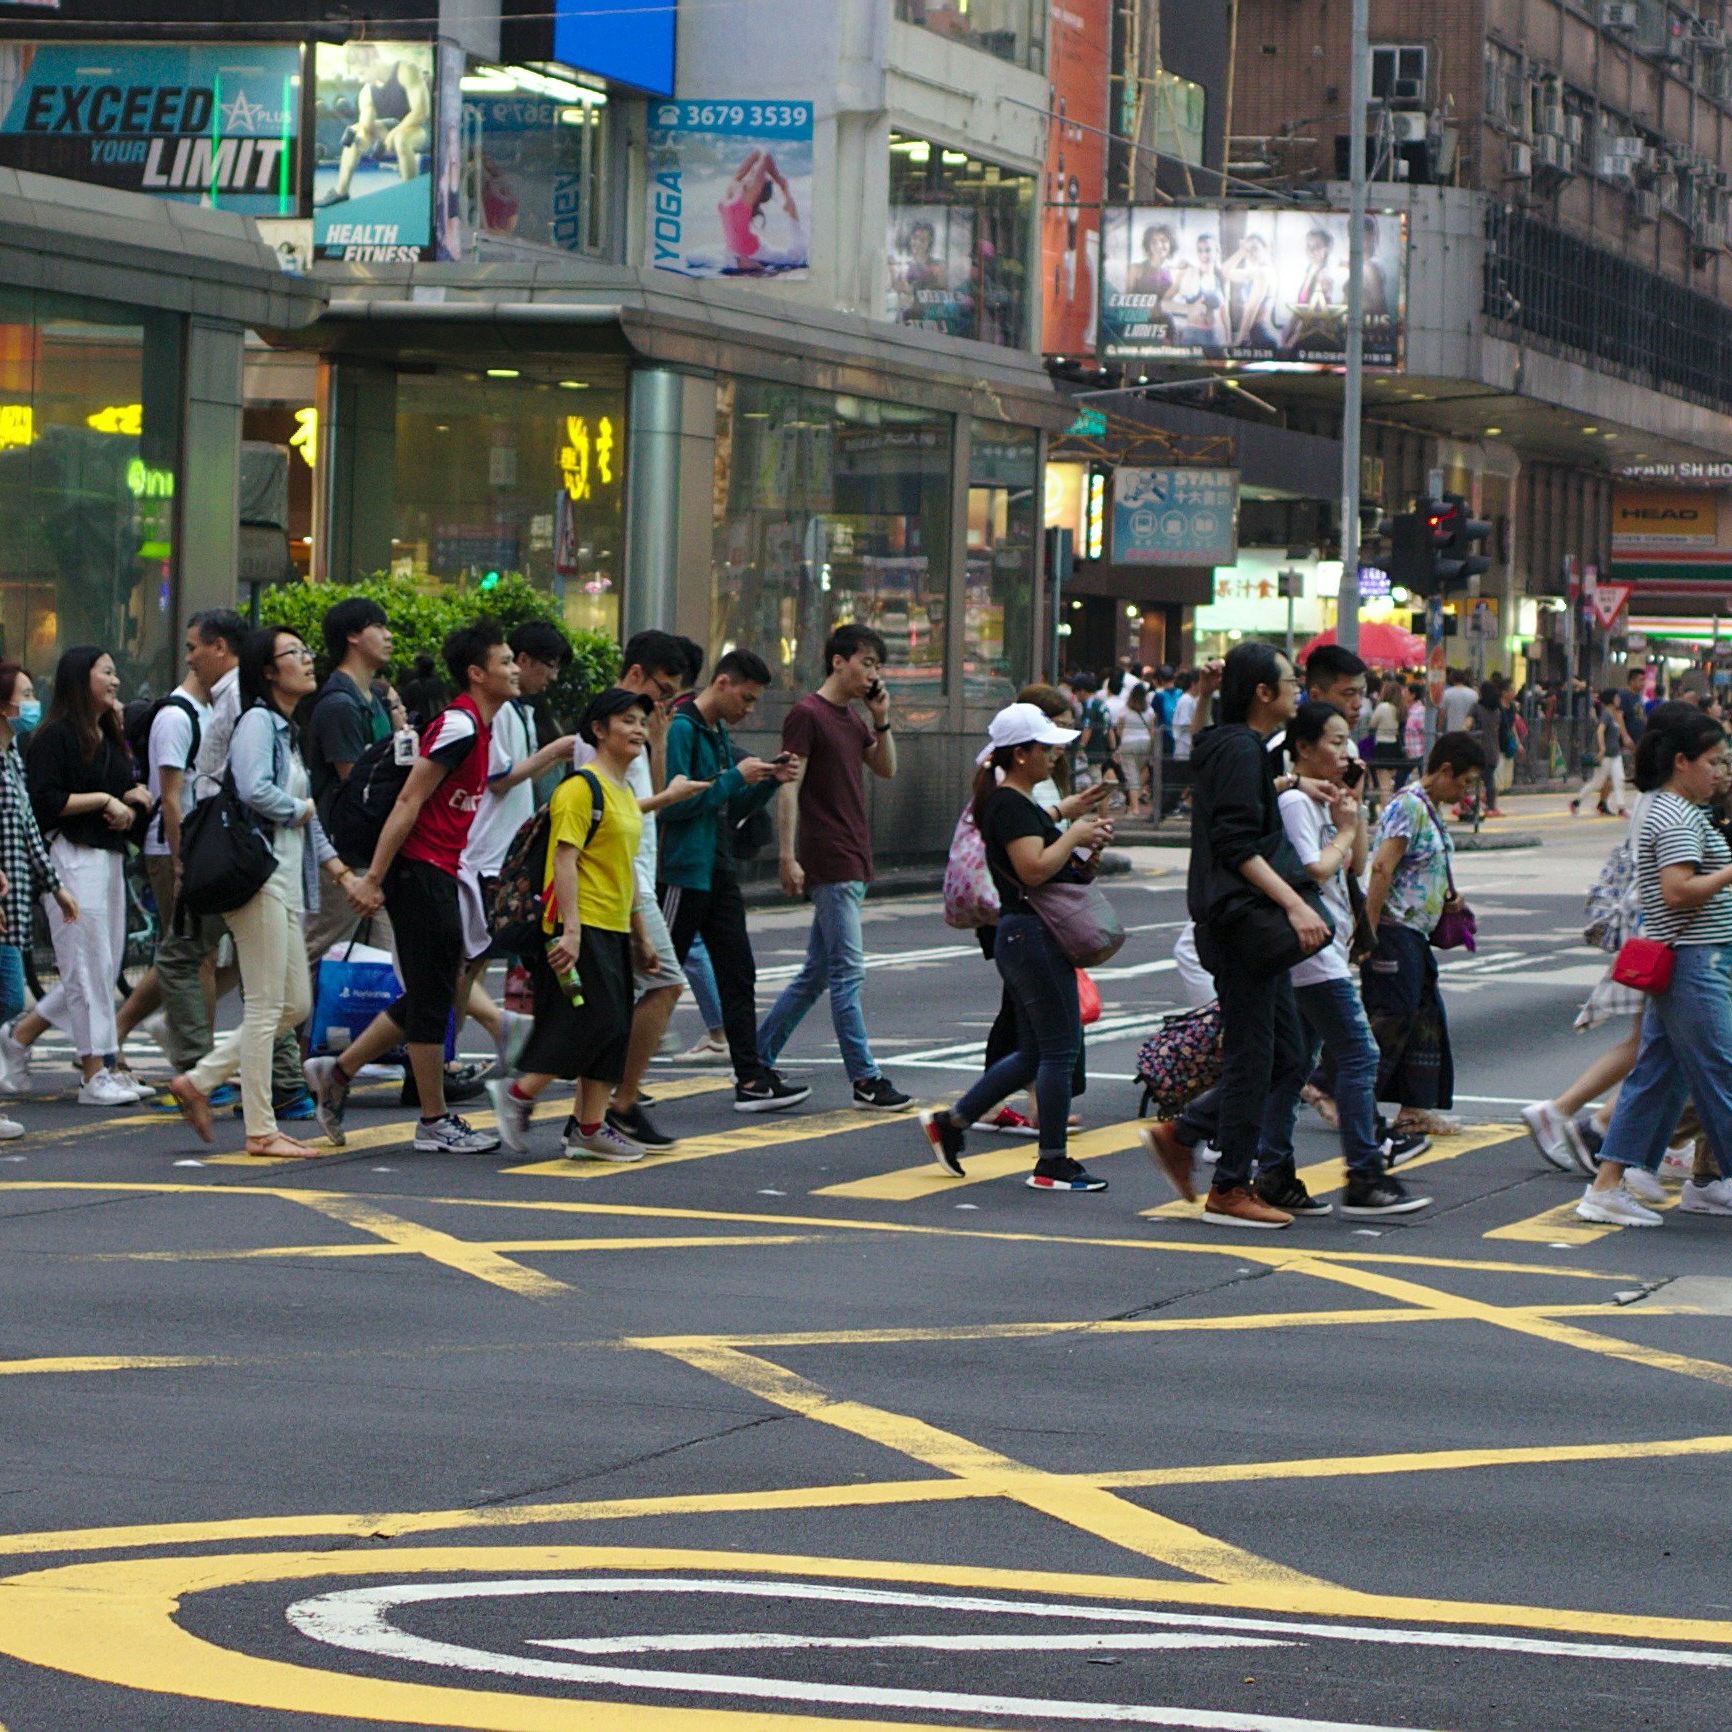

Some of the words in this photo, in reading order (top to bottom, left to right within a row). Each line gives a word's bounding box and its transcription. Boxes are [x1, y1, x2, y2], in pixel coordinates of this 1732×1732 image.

[22, 85, 216, 133] EXCEED
[687, 105, 744, 126] 3679
[749, 105, 808, 127] 3539
[90, 139, 149, 163] YOUR
[141, 137, 287, 188] LIMIT
[654, 171, 683, 261] YOGA
[325, 223, 399, 245] HEALTH
[343, 245, 421, 262] FITNESS
[1109, 293, 1158, 308] EXCEED
[1622, 507, 1699, 520] HEAD
